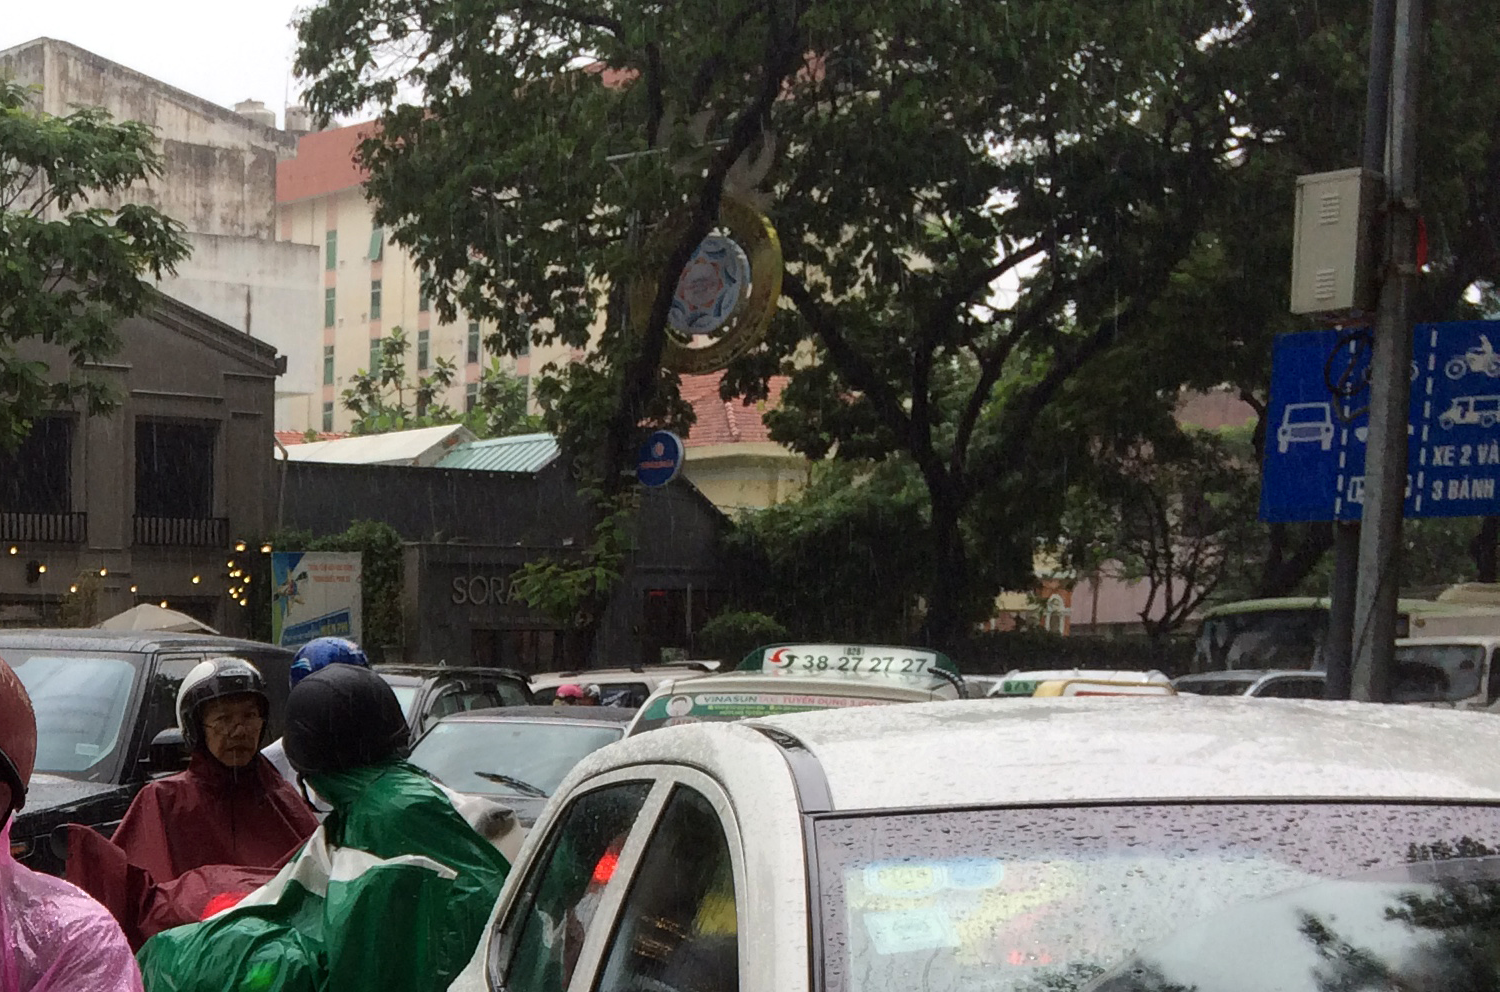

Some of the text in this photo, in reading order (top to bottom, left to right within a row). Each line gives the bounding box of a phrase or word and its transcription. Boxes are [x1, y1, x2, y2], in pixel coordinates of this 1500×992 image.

[1432, 445, 1455, 466] XE
[1459, 444, 1472, 466] 2
[1431, 474, 1495, 501] 3 BÁNH
[868, 656, 895, 673] 27
[902, 658, 928, 673] 27
